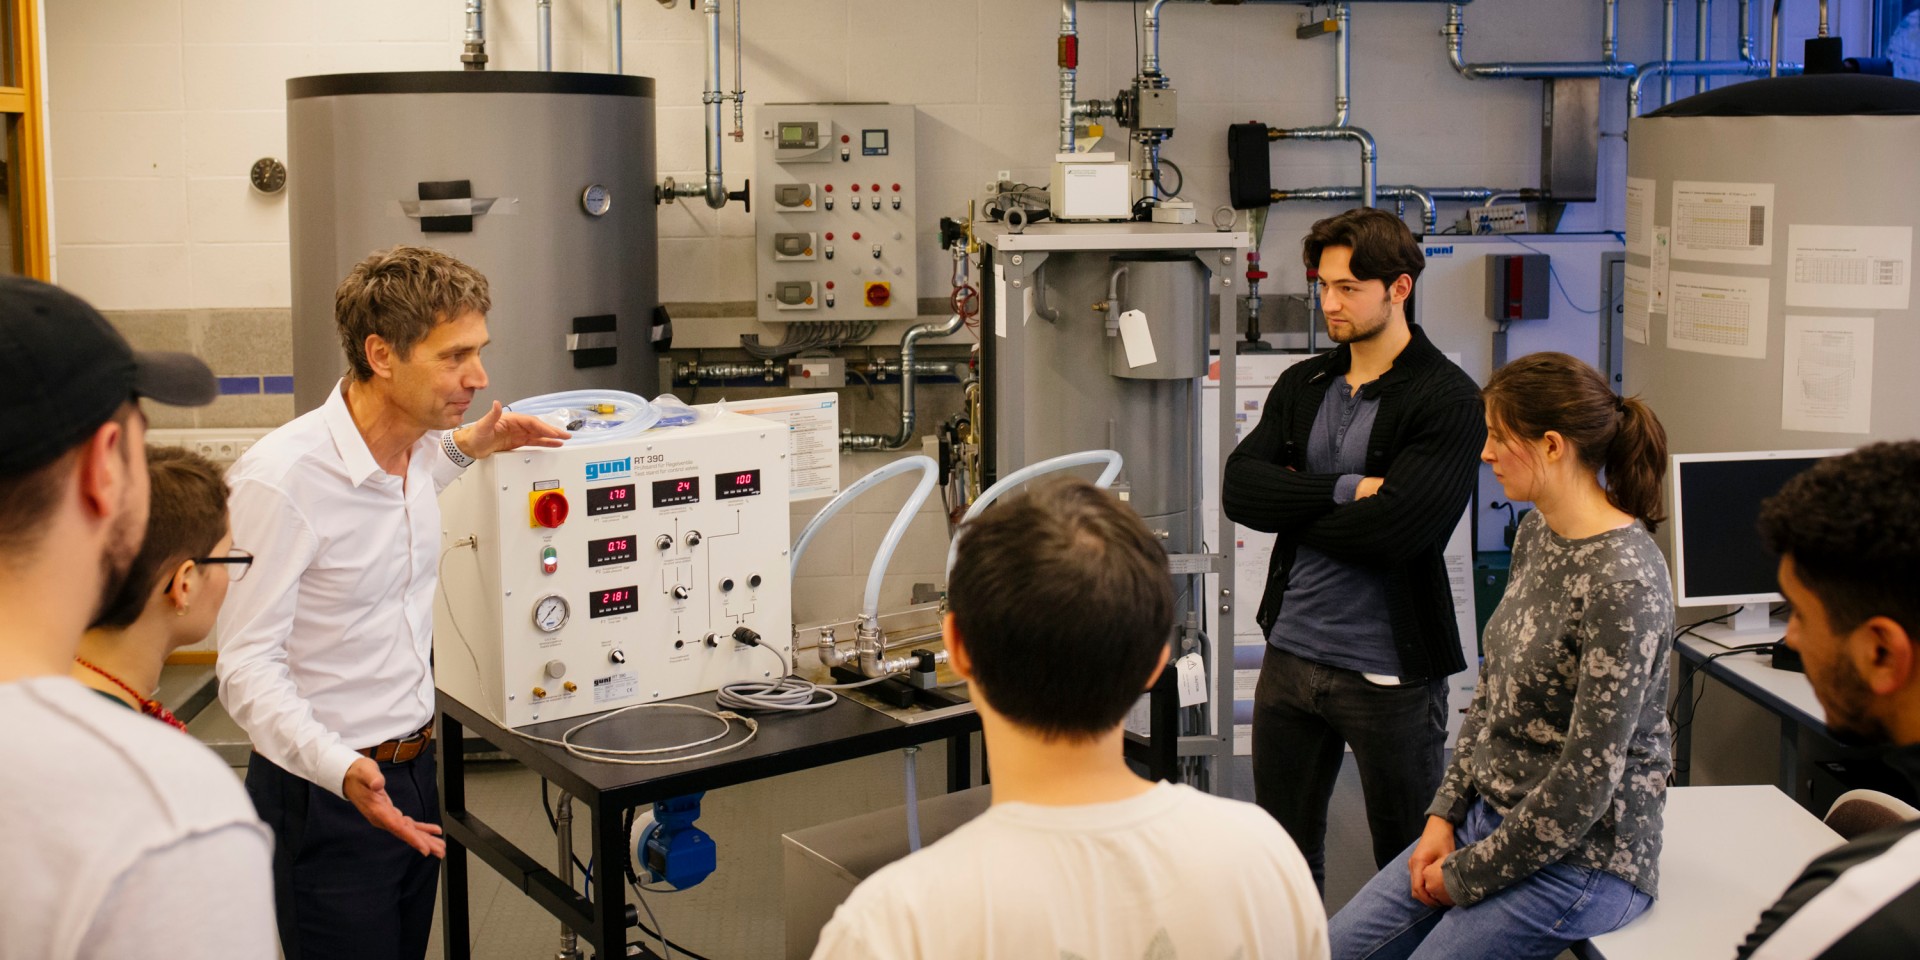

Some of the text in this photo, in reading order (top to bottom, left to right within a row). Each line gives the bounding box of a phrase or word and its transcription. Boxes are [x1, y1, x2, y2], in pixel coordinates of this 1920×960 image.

[1425, 245, 1453, 257] gunt
[634, 454, 664, 465] RT 390
[585, 456, 631, 480] gunt
[736, 474, 752, 484] 100
[677, 482, 691, 492] 24
